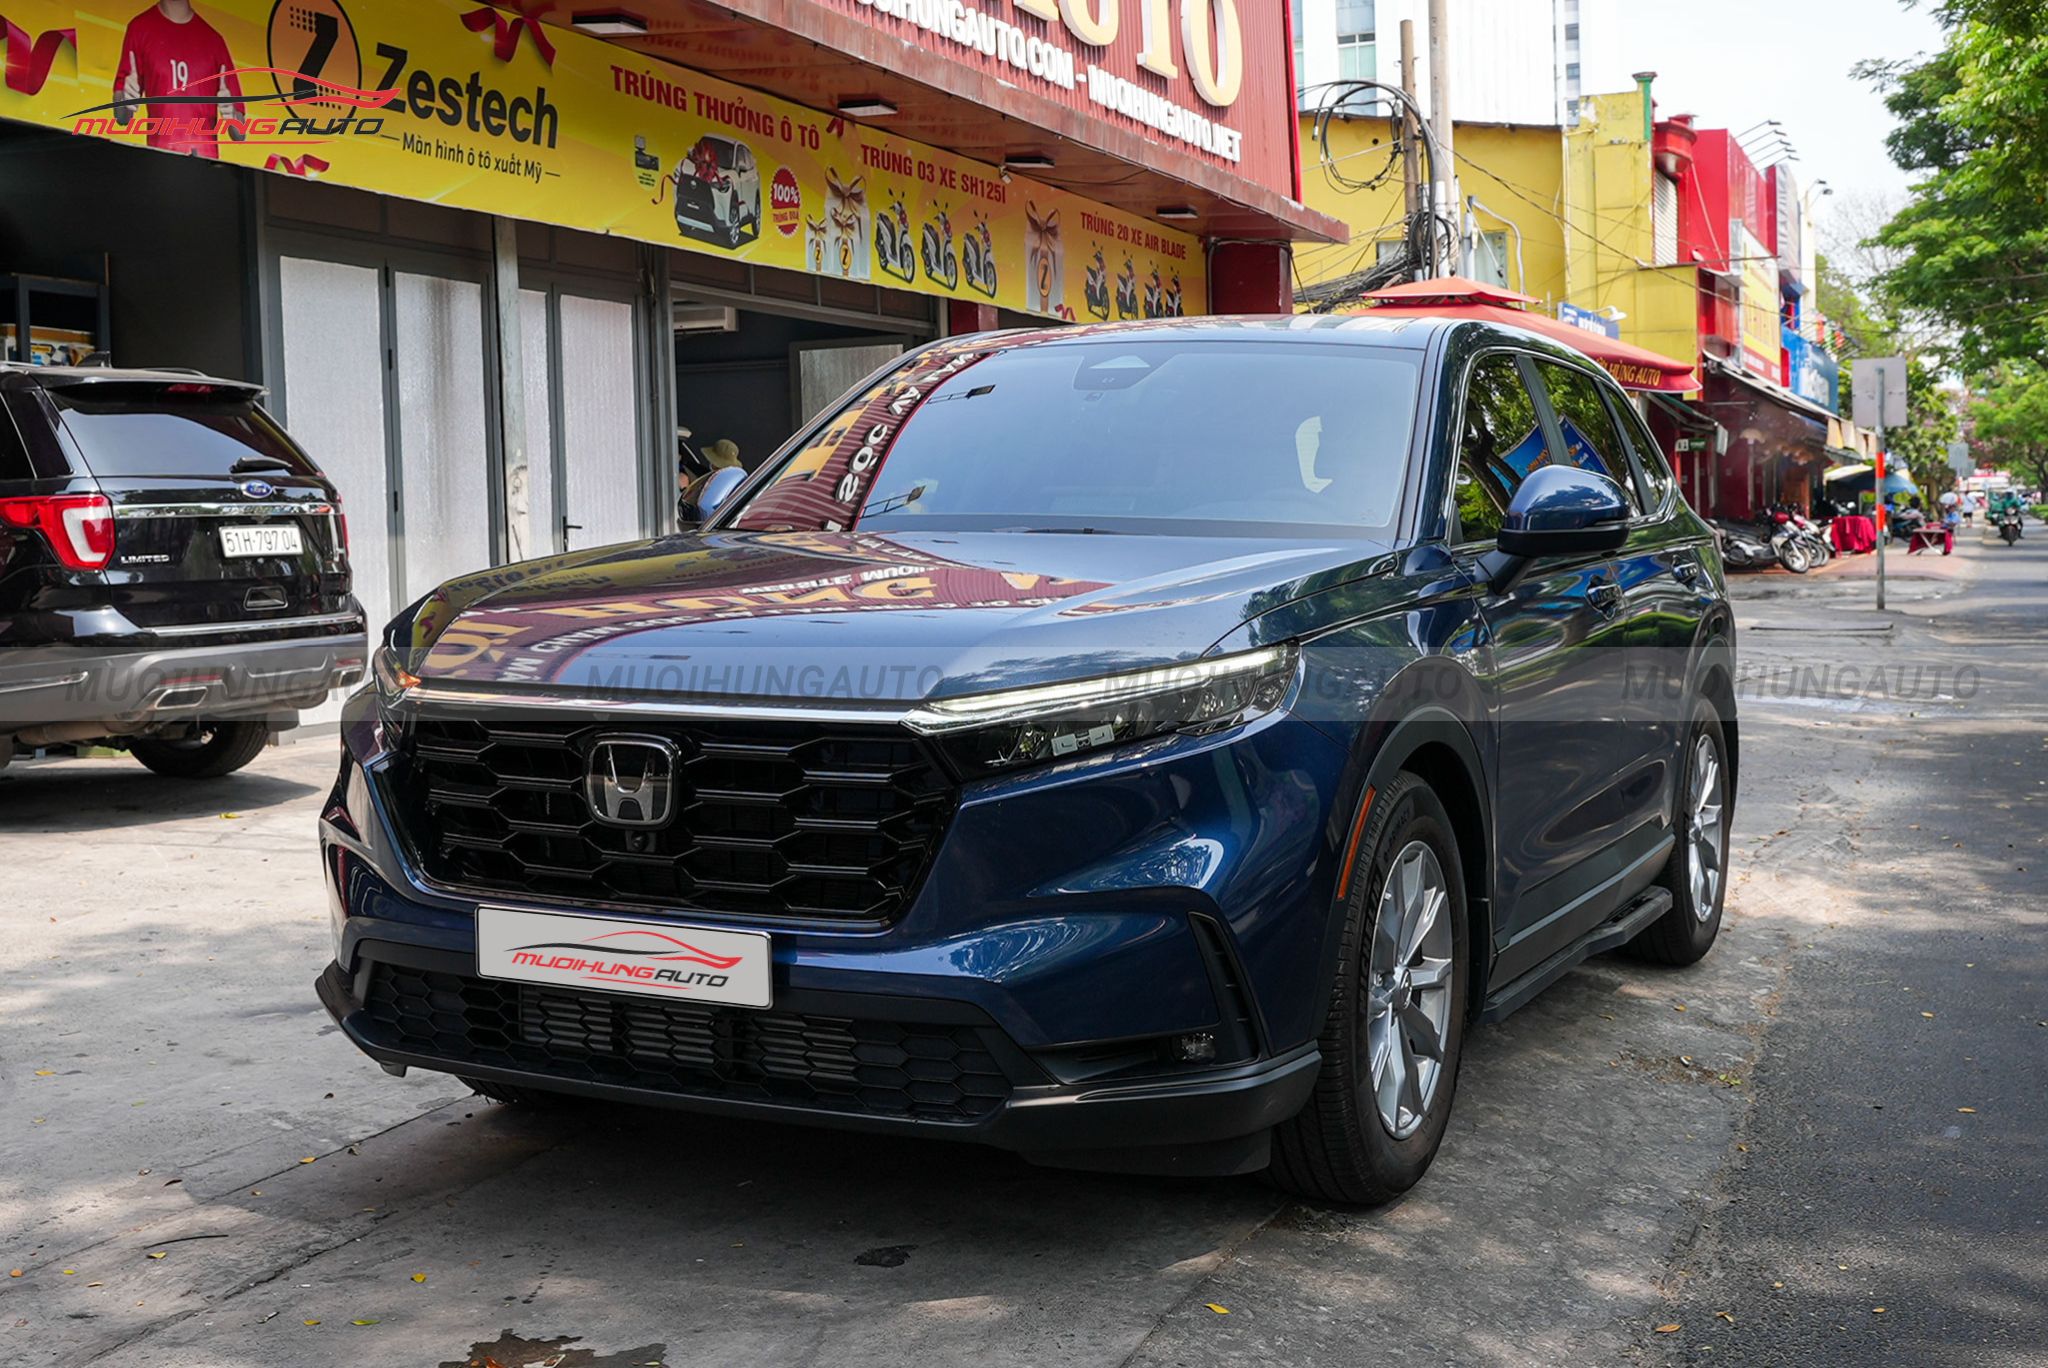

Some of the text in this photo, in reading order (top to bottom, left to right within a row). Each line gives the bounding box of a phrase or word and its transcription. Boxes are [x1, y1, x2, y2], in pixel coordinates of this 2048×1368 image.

[170, 59, 189, 91] 19
[372, 42, 559, 150] Zestech
[610, 65, 820, 150] TRÚNG THƯỞNG Ô TÔ
[402, 132, 543, 184] Màn hình ô tô xuất Mỹ
[860, 143, 1006, 204] TRÚNG 03 XE SH125I
[773, 183, 799, 204] 100%
[1080, 211, 1187, 260] TRÚNG 20 XE AIR BLADE
[1635, 366, 1662, 386] AUTO
[120, 554, 170, 564] LIMITED
